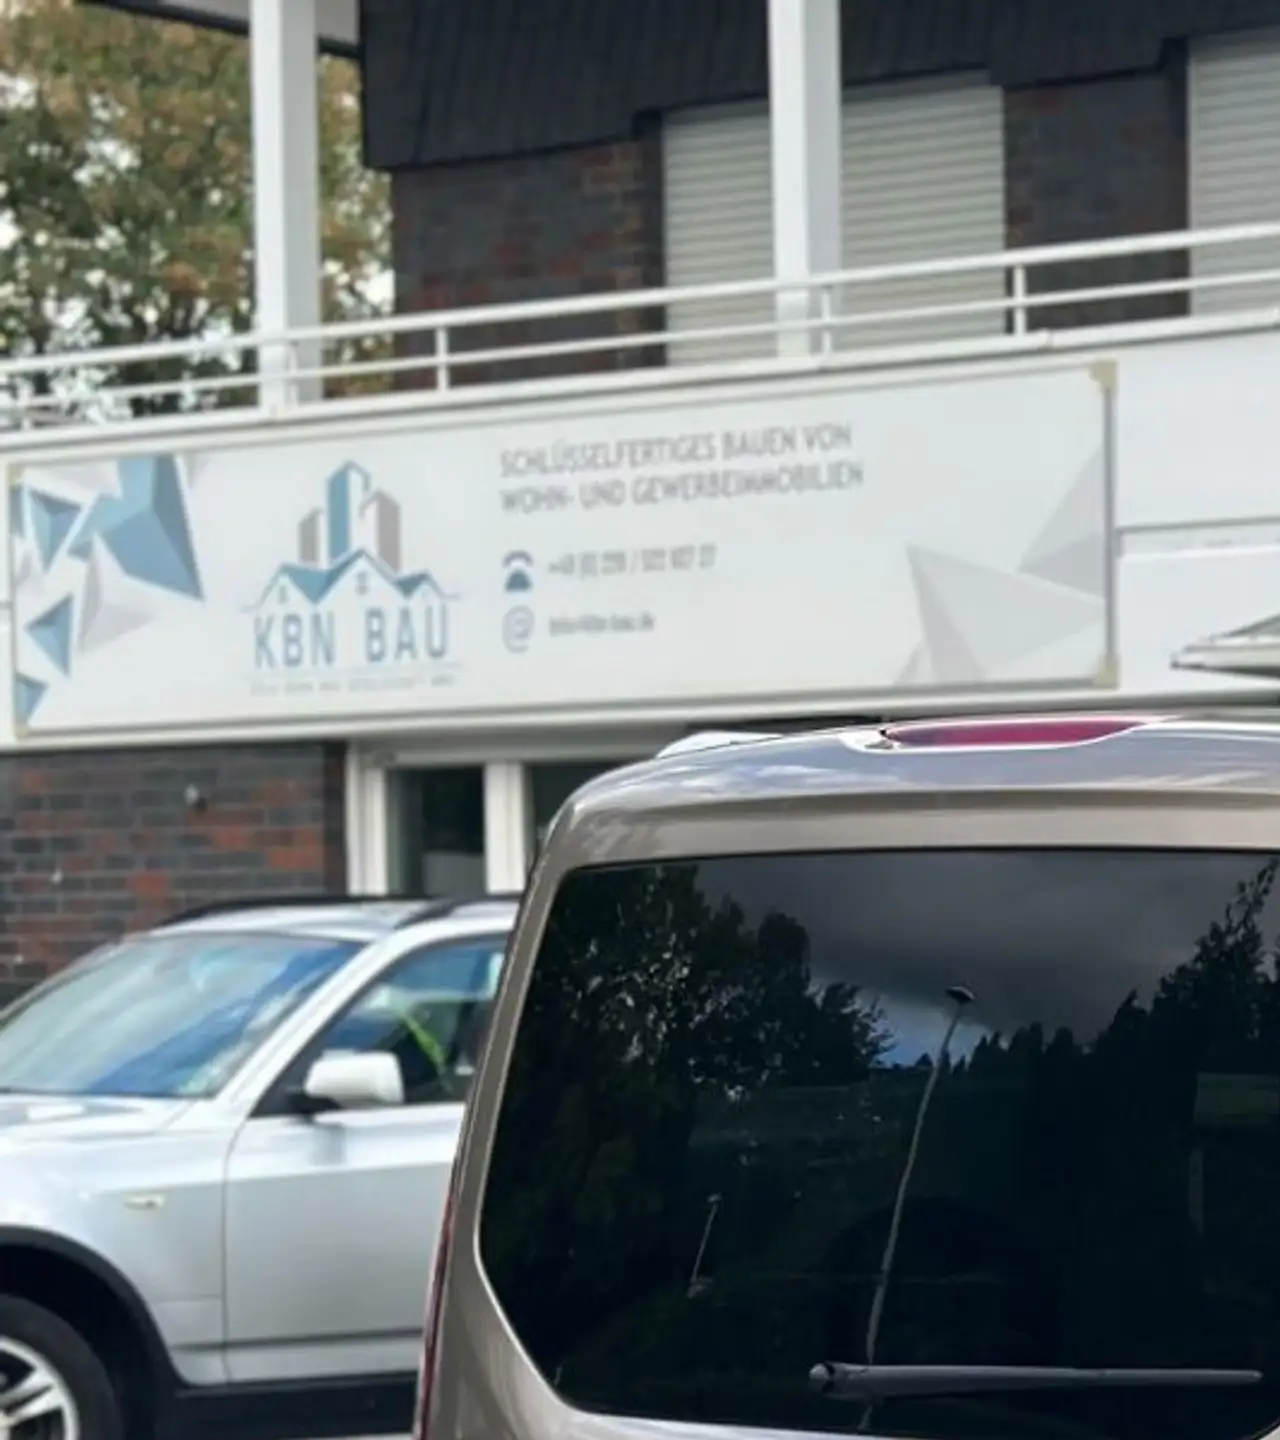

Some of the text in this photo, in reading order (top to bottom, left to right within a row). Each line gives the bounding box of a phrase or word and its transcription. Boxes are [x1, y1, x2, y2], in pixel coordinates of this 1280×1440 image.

[500, 420, 852, 478] SCHLÜSSELFERTIGES BAUEN VON
[500, 459, 864, 514] WOHN- UND GEWERBEIMMOBILIEN
[253, 603, 449, 669] KBN BAU
